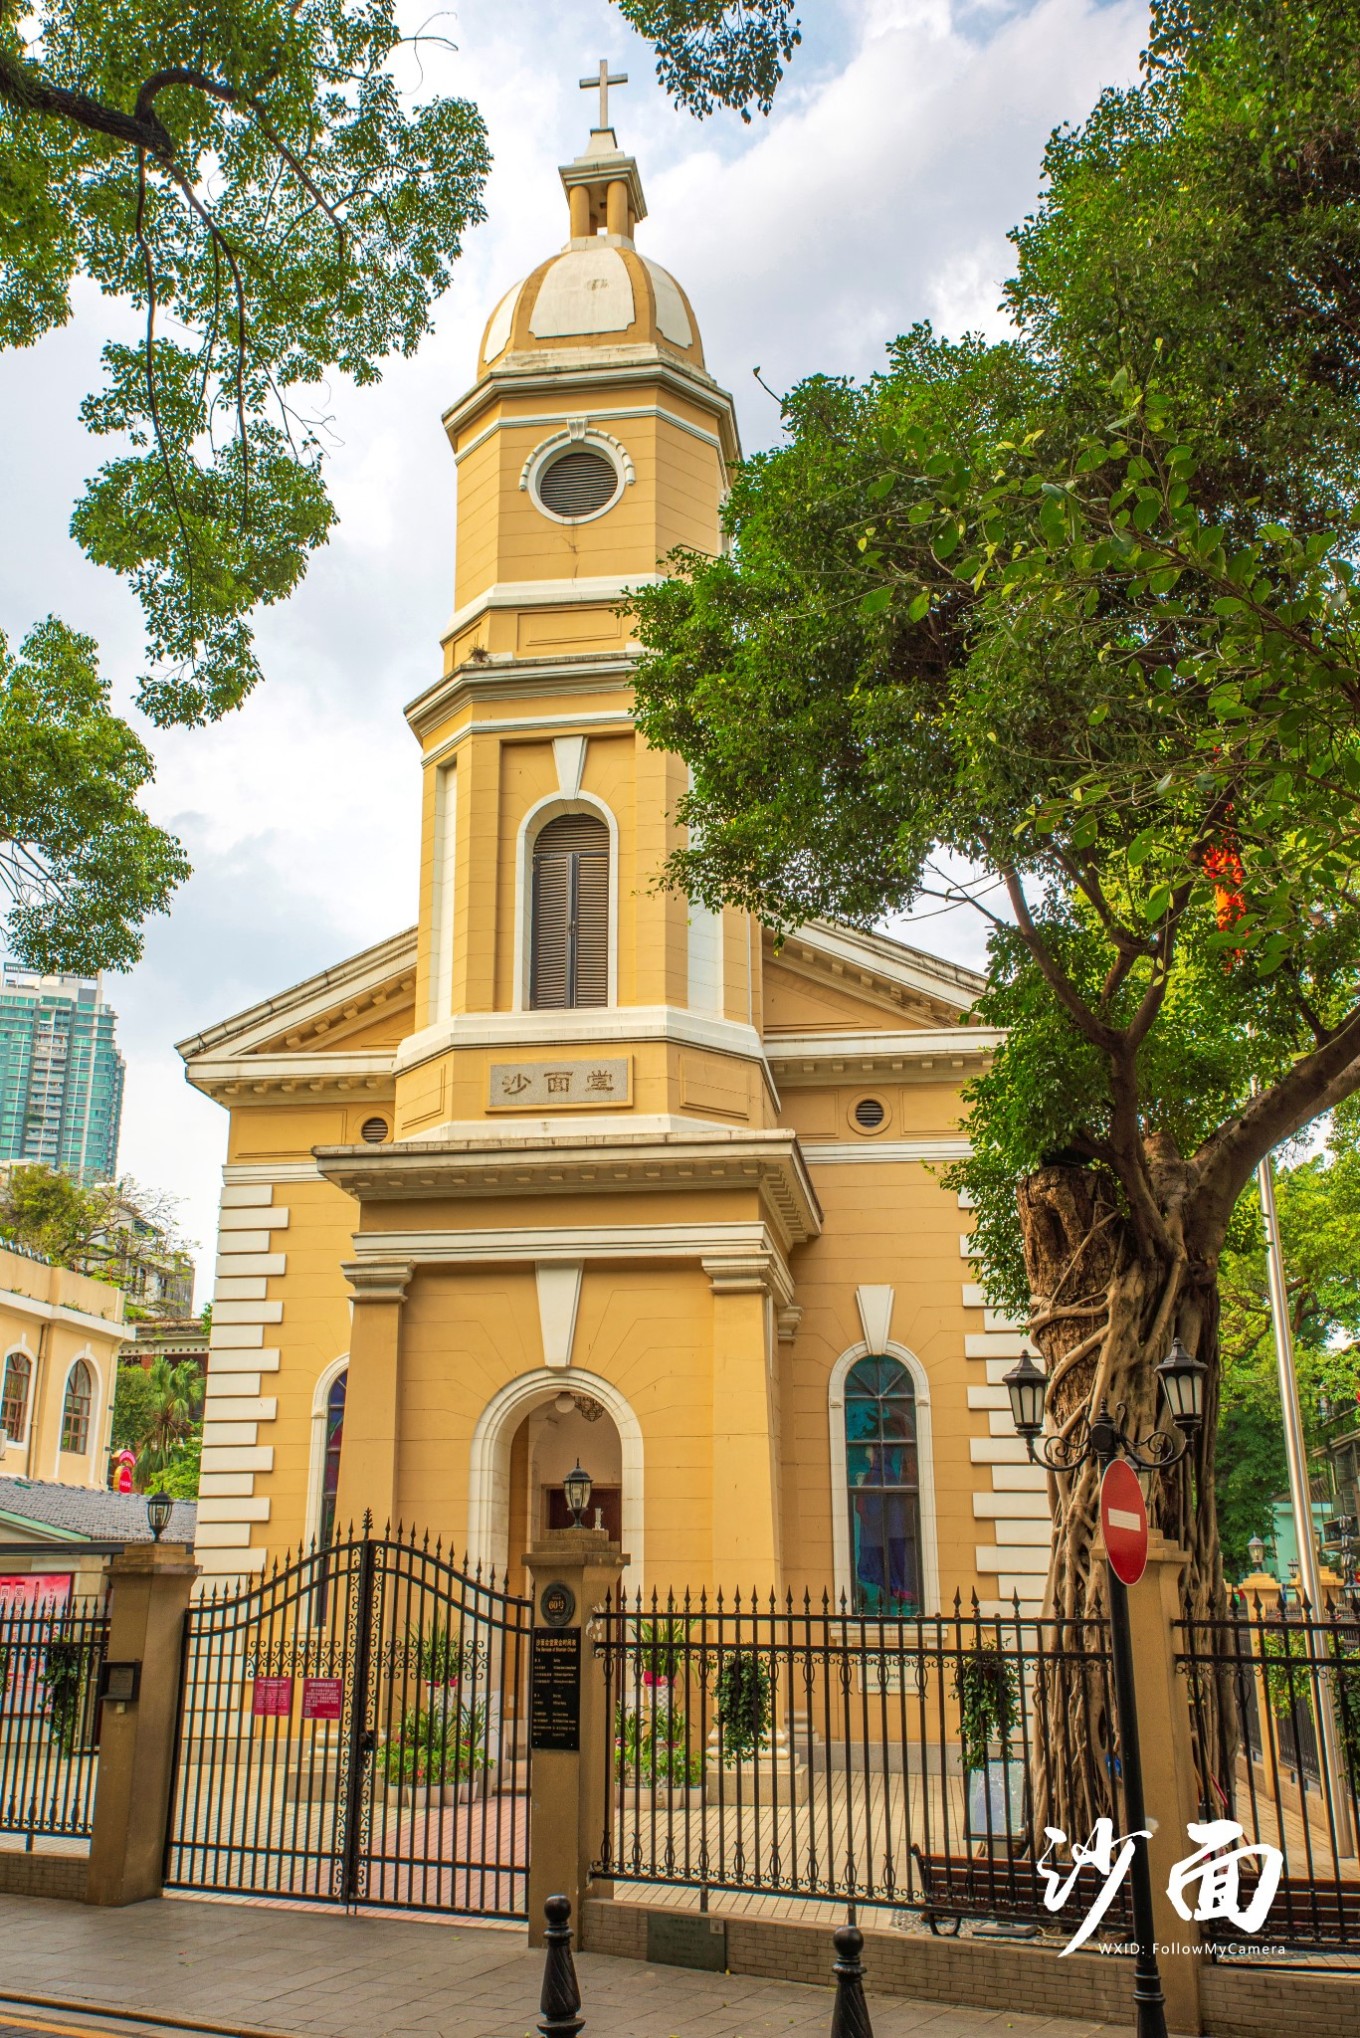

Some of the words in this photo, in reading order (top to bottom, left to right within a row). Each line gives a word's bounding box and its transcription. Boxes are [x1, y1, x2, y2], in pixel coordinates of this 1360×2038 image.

[501, 1069, 615, 1096] 沙面堂
[548, 1600, 565, 1610] 60号
